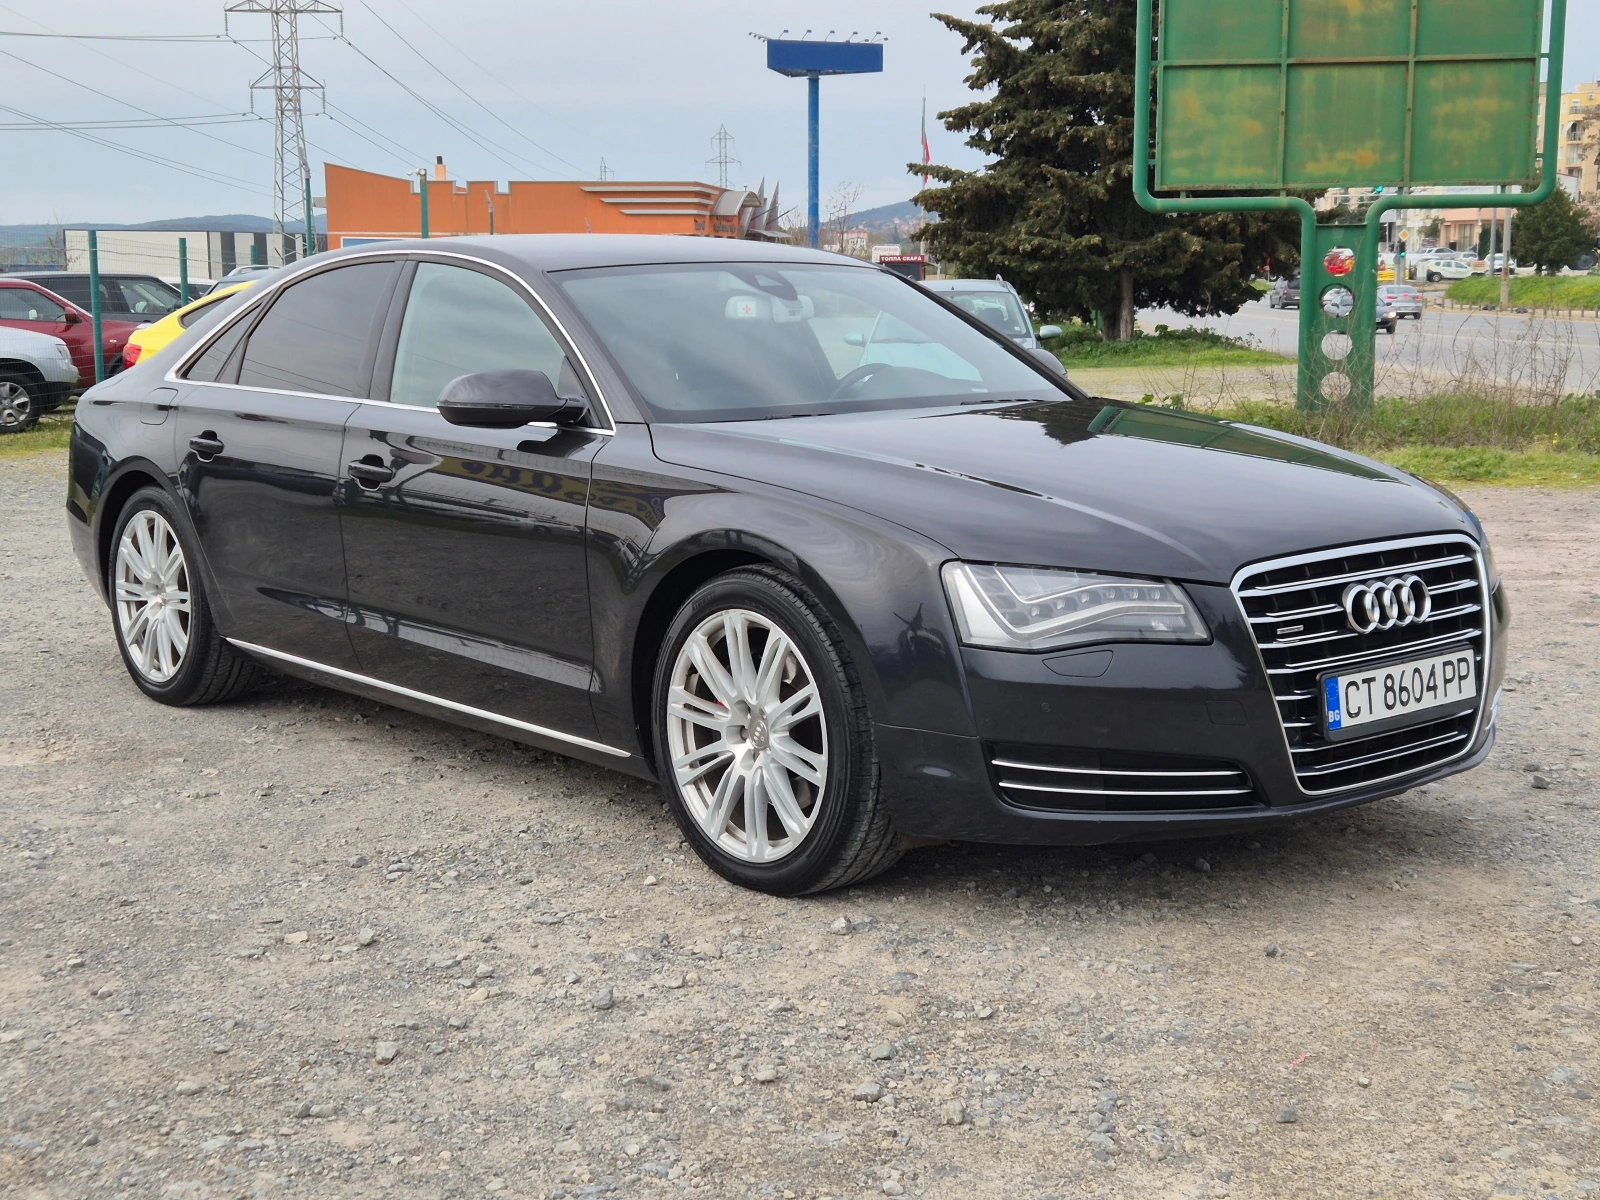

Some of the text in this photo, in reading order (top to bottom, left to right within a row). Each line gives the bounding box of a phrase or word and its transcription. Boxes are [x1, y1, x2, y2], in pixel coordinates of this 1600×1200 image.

[1344, 656, 1470, 719] CT 8604 PP
[1328, 709, 1340, 723] BG
